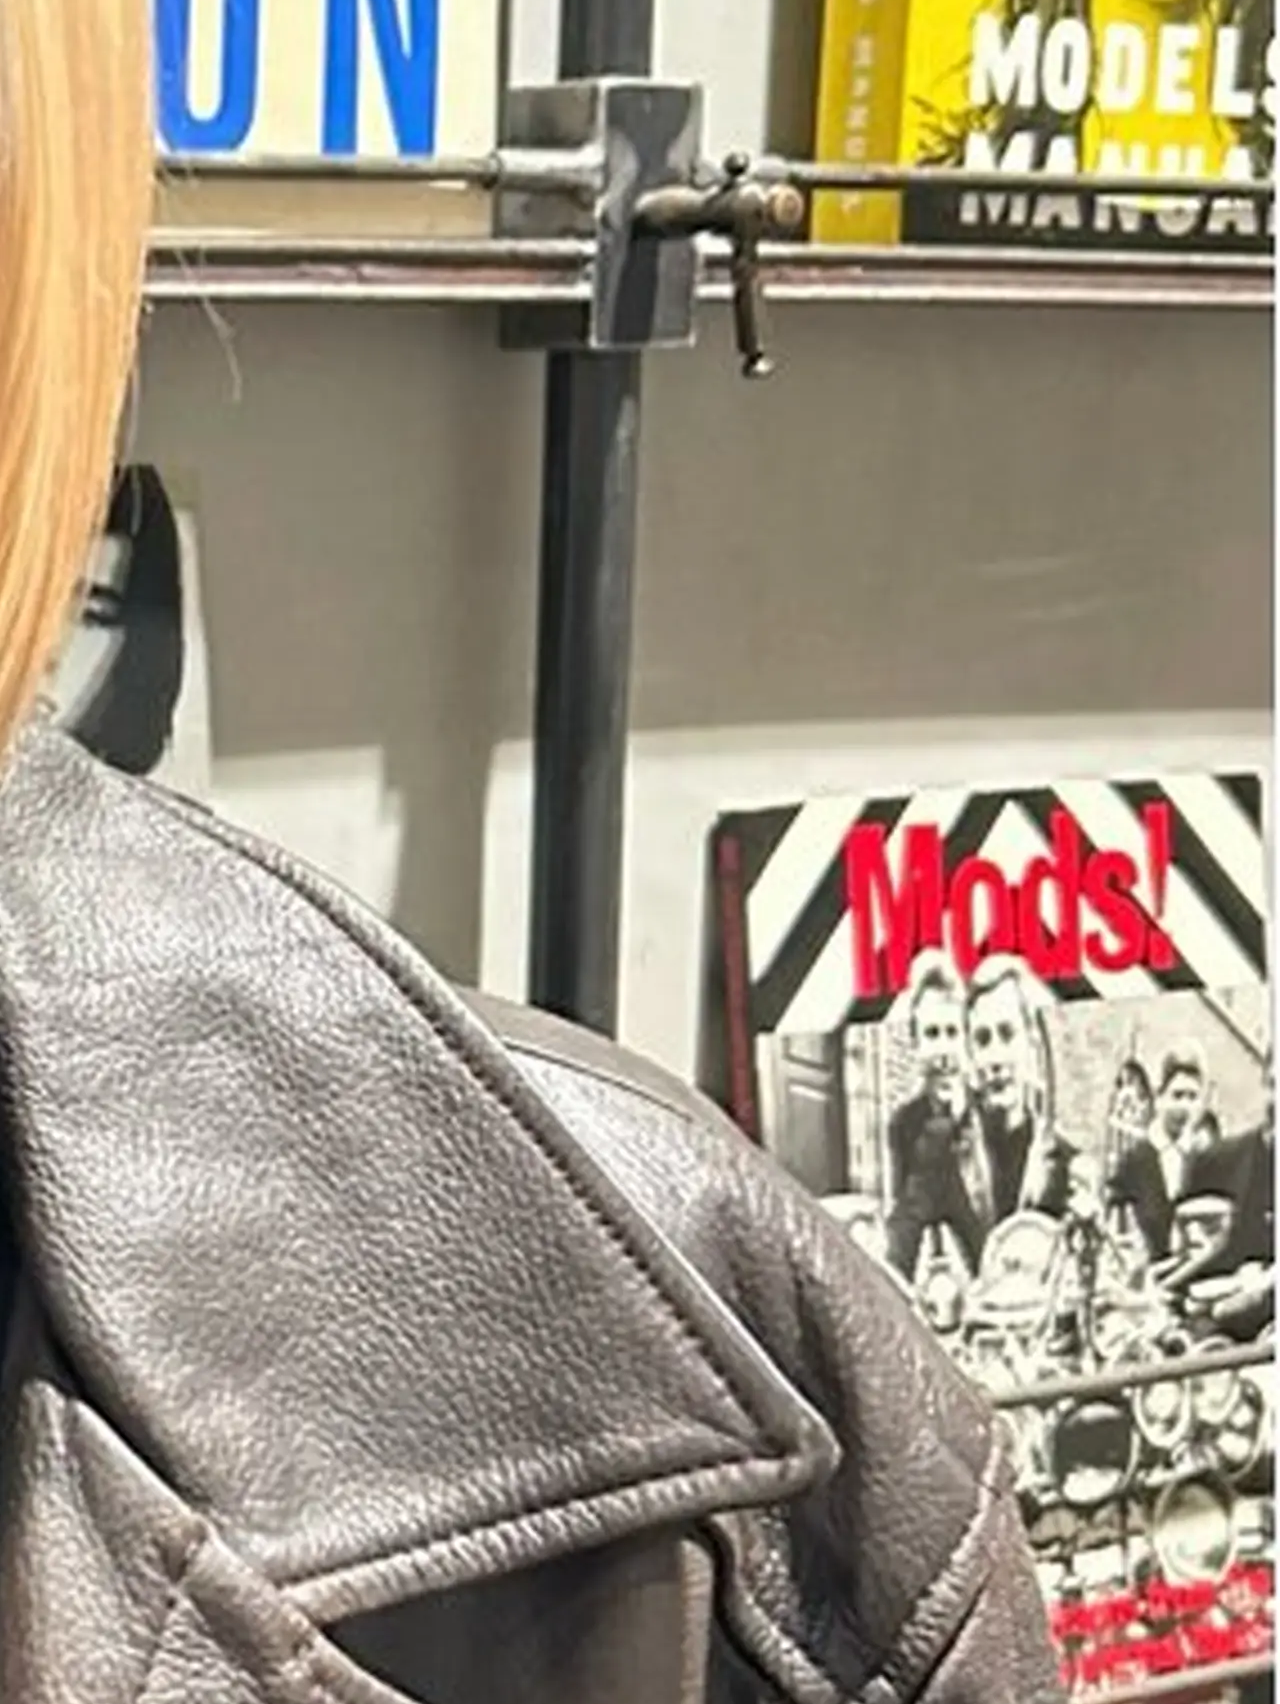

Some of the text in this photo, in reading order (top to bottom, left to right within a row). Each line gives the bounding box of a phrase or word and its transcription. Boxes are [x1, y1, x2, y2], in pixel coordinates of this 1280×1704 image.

[842, 33, 876, 214] MANUL
[968, 11, 1275, 118] MODEL
[959, 131, 1275, 237] MANUA
[842, 800, 1177, 999] Mods!
